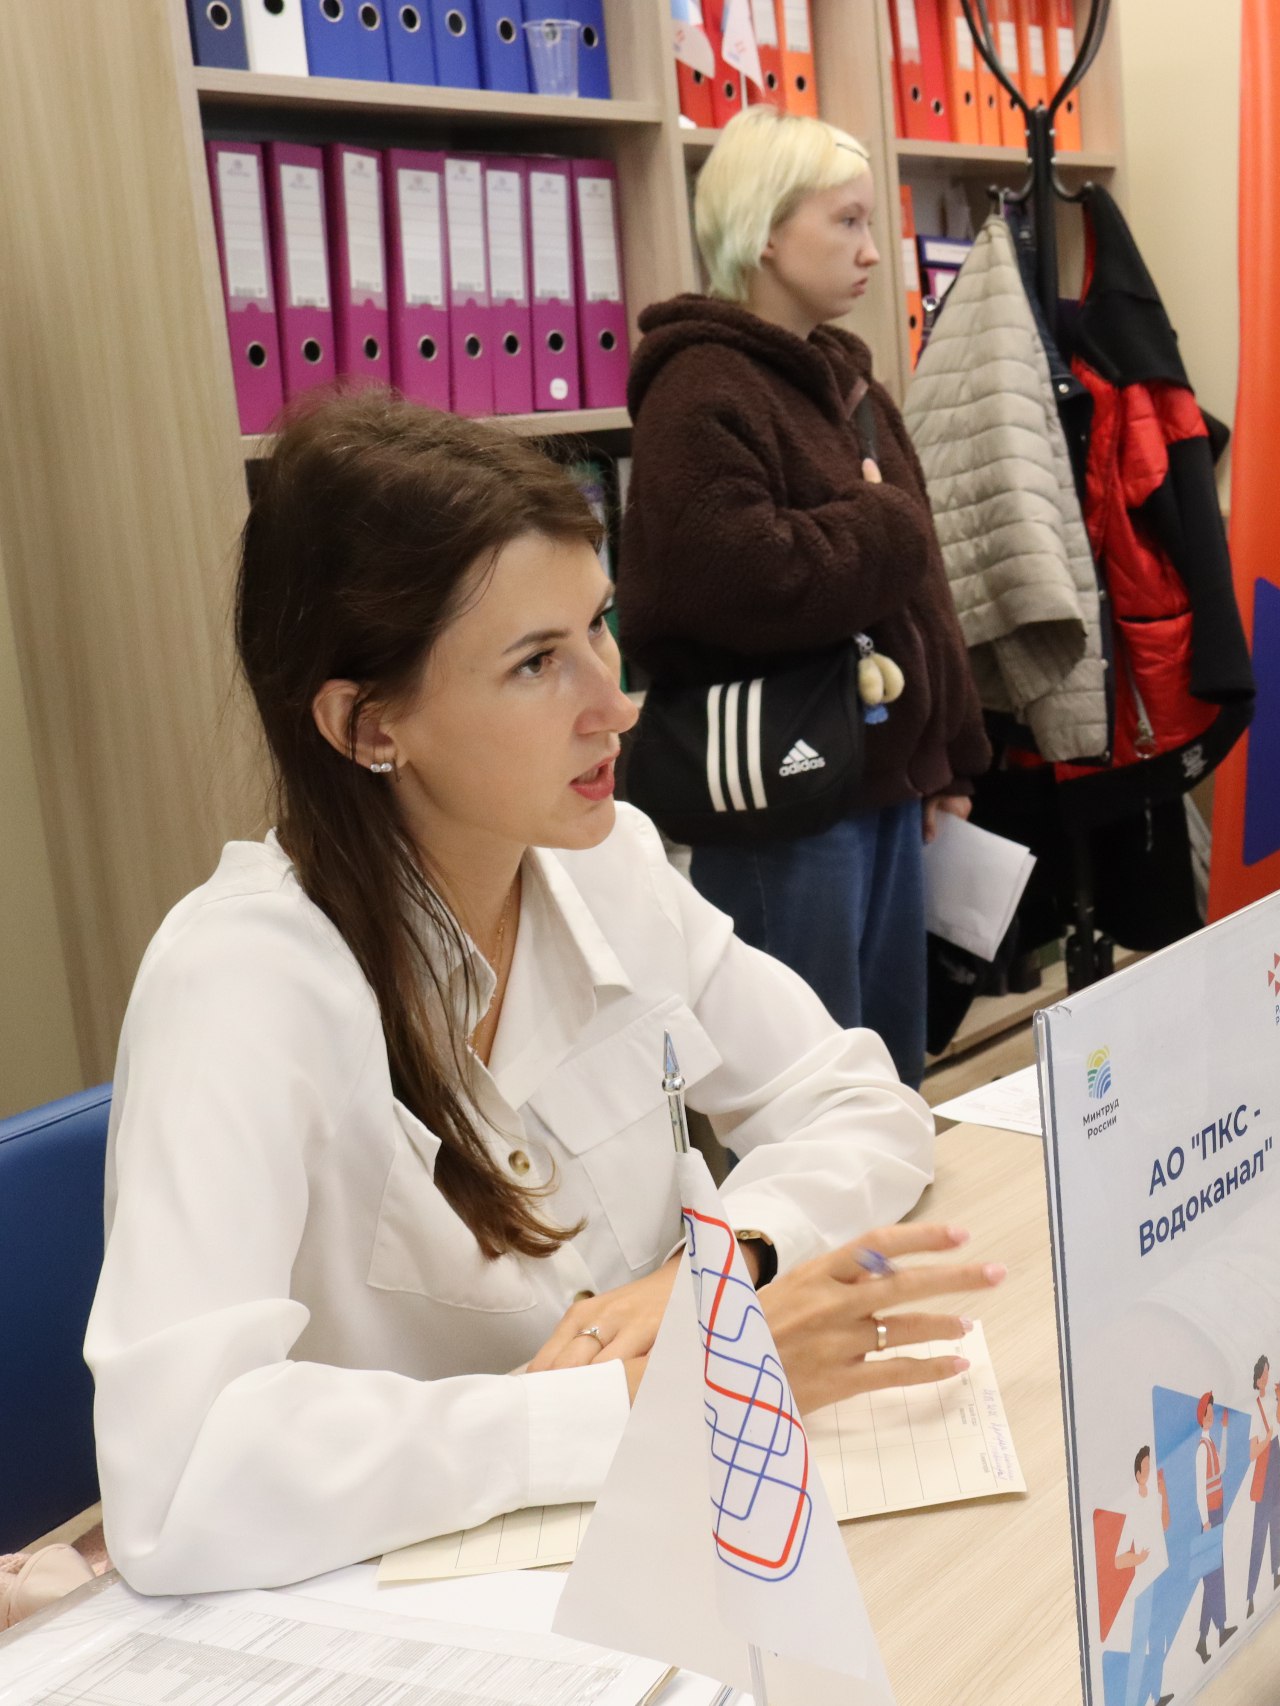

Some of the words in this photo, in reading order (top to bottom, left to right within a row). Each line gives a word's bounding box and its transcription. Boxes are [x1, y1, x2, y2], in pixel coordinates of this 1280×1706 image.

[779, 757, 826, 777] adidas
[1082, 1098, 1120, 1127] Минтруд
[1087, 1115, 1117, 1140] России
[1149, 1146, 1185, 1197] АО
[1191, 1104, 1248, 1161] "ПКС
[1139, 1136, 1273, 1258] Водоканал"
